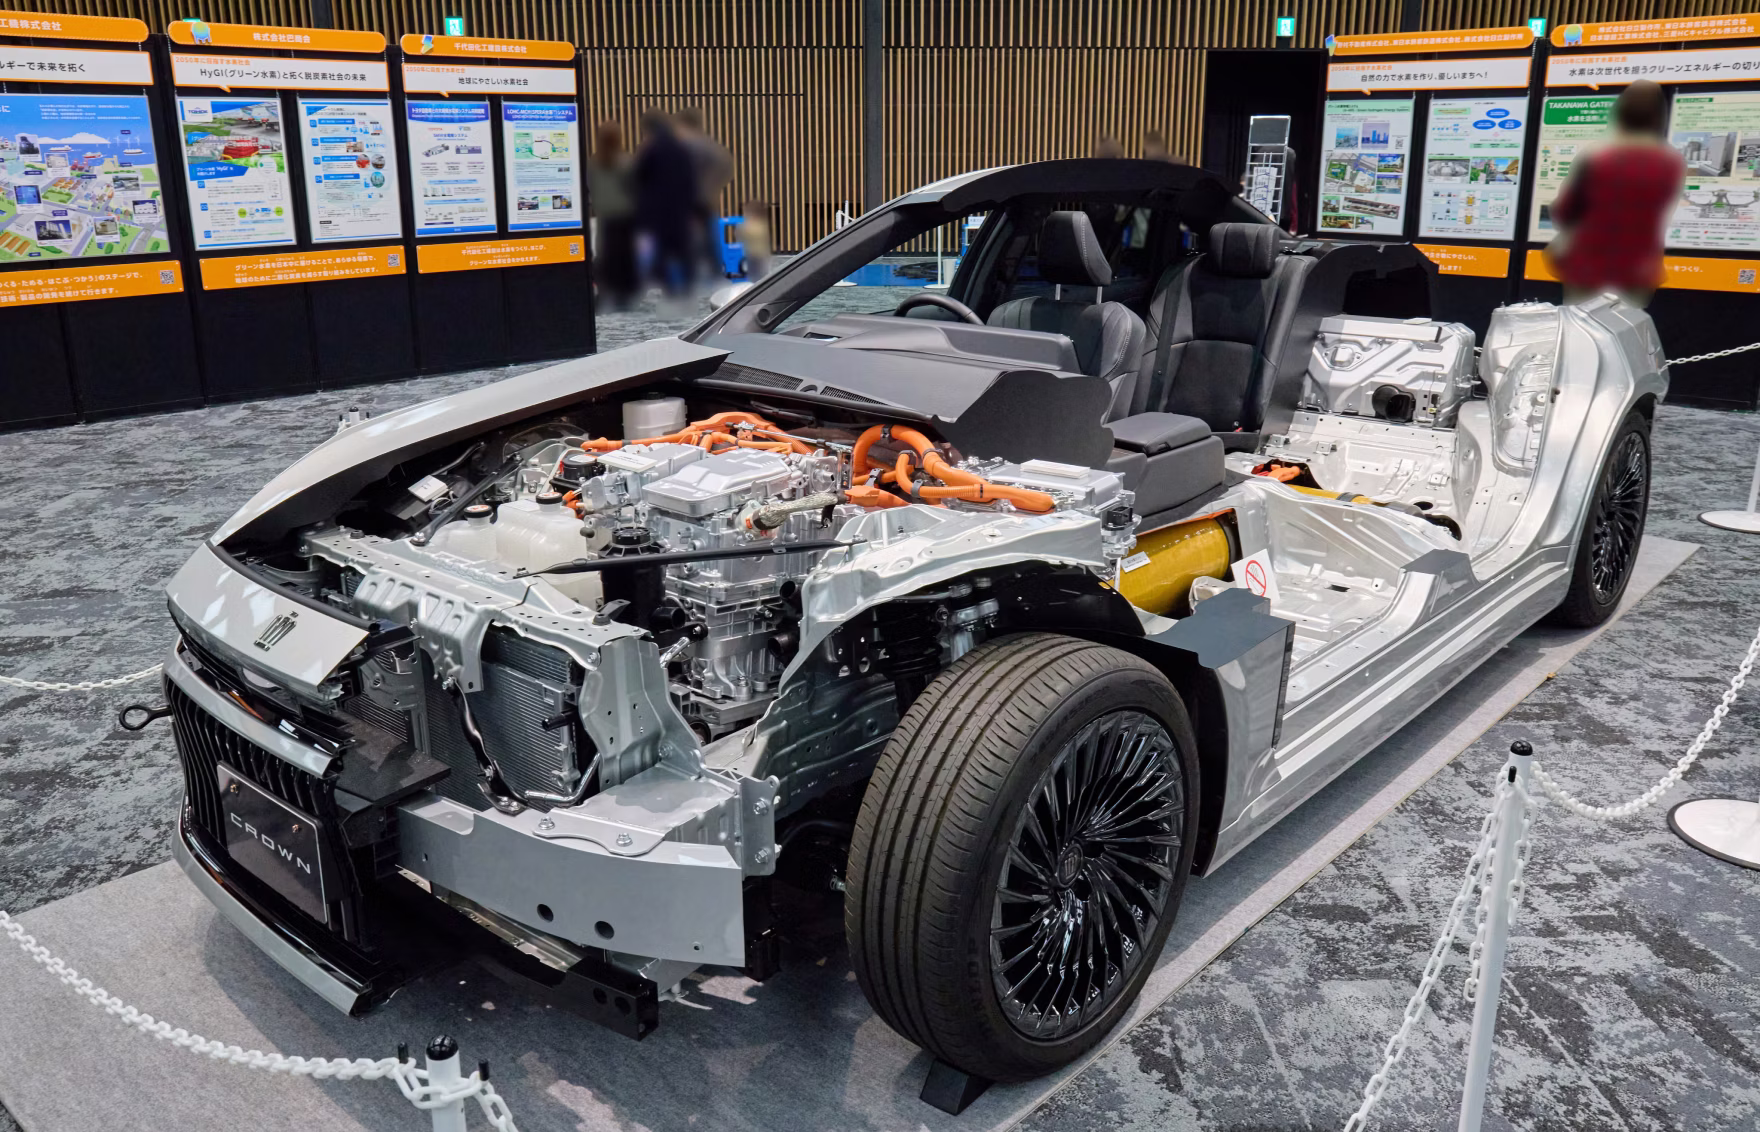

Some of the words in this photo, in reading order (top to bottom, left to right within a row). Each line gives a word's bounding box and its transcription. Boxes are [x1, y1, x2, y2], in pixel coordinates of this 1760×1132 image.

[458, 77, 529, 86] 地球にやさしい水素社会
[1549, 101, 1588, 109] TAKANAWA
[230, 812, 311, 875] CROWN
